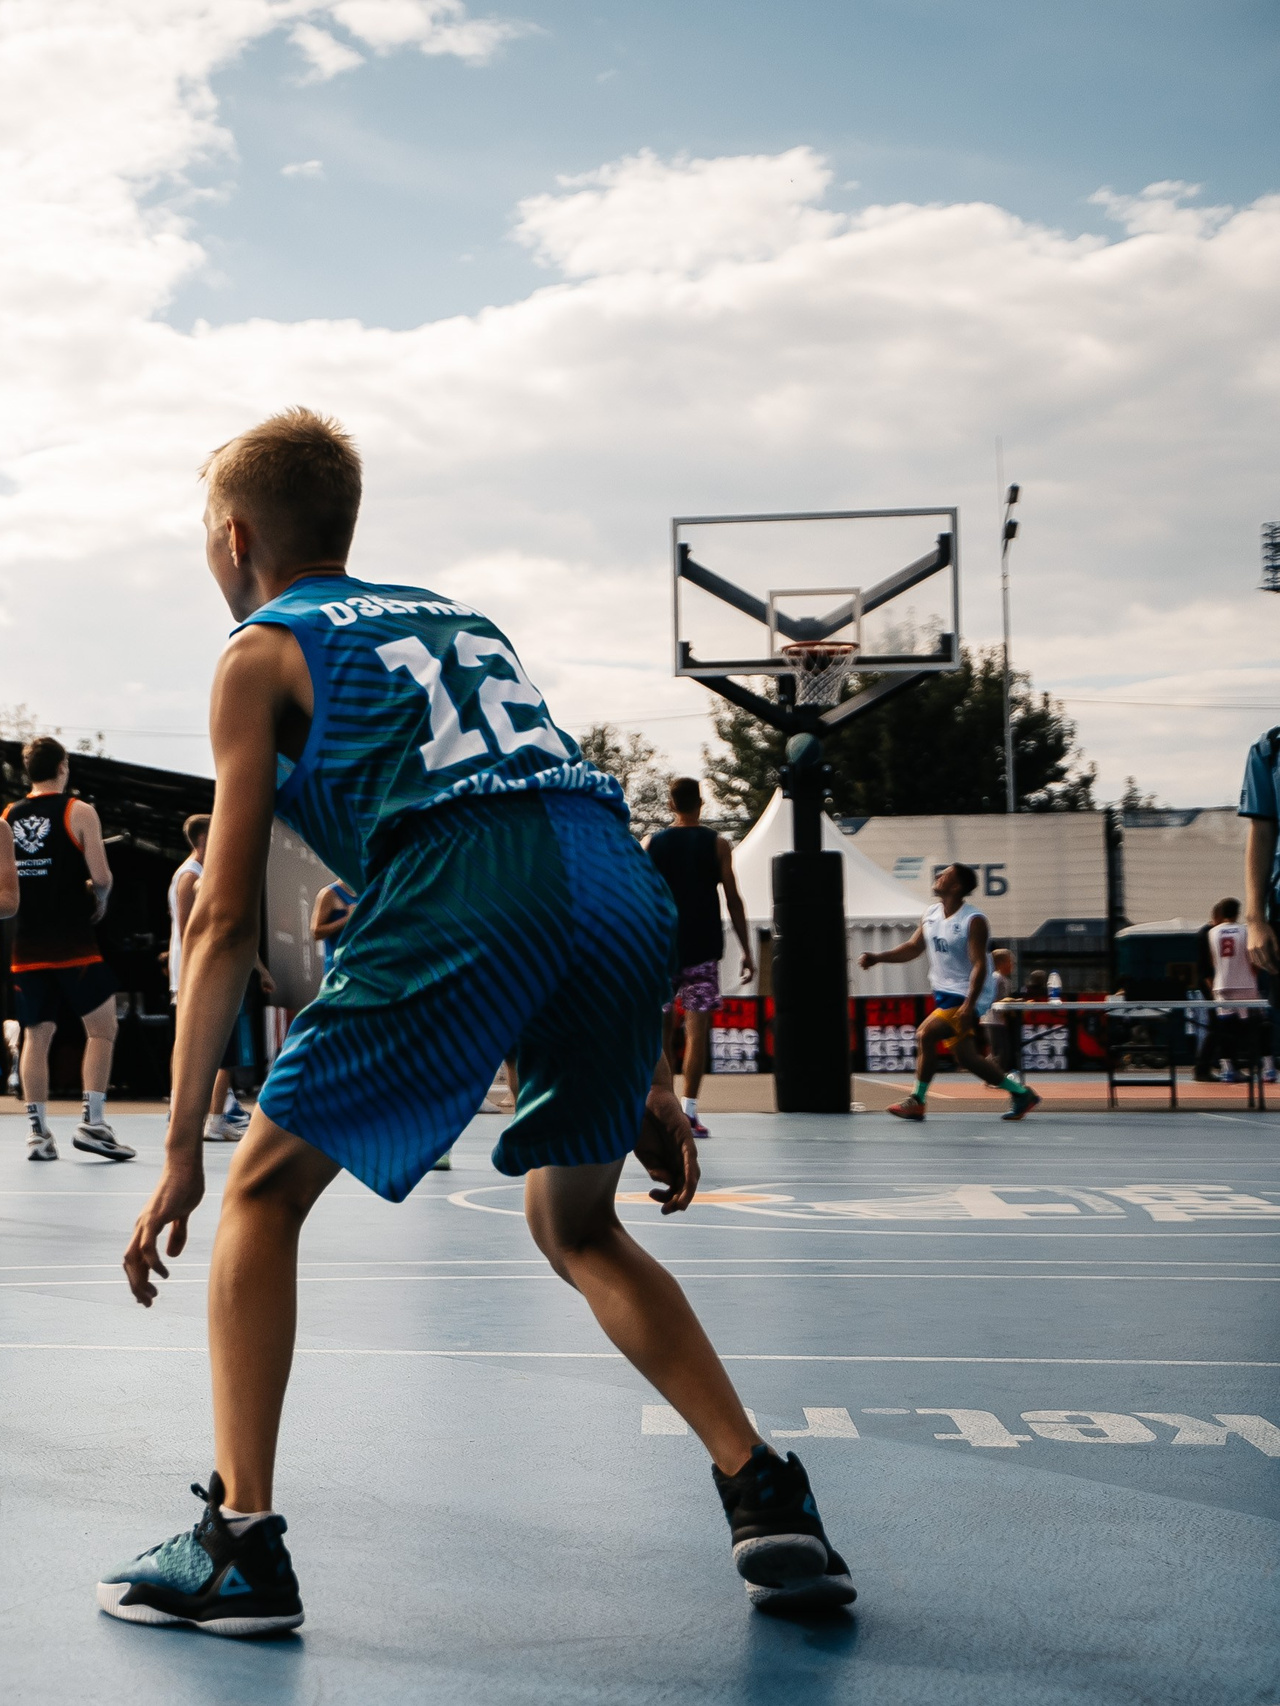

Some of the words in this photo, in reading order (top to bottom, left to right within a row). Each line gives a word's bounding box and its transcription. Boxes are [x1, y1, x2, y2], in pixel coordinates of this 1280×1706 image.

[375, 630, 571, 772] 12
[17, 868, 48, 876] ОССИИ
[867, 1041, 918, 1056] КЕТ
